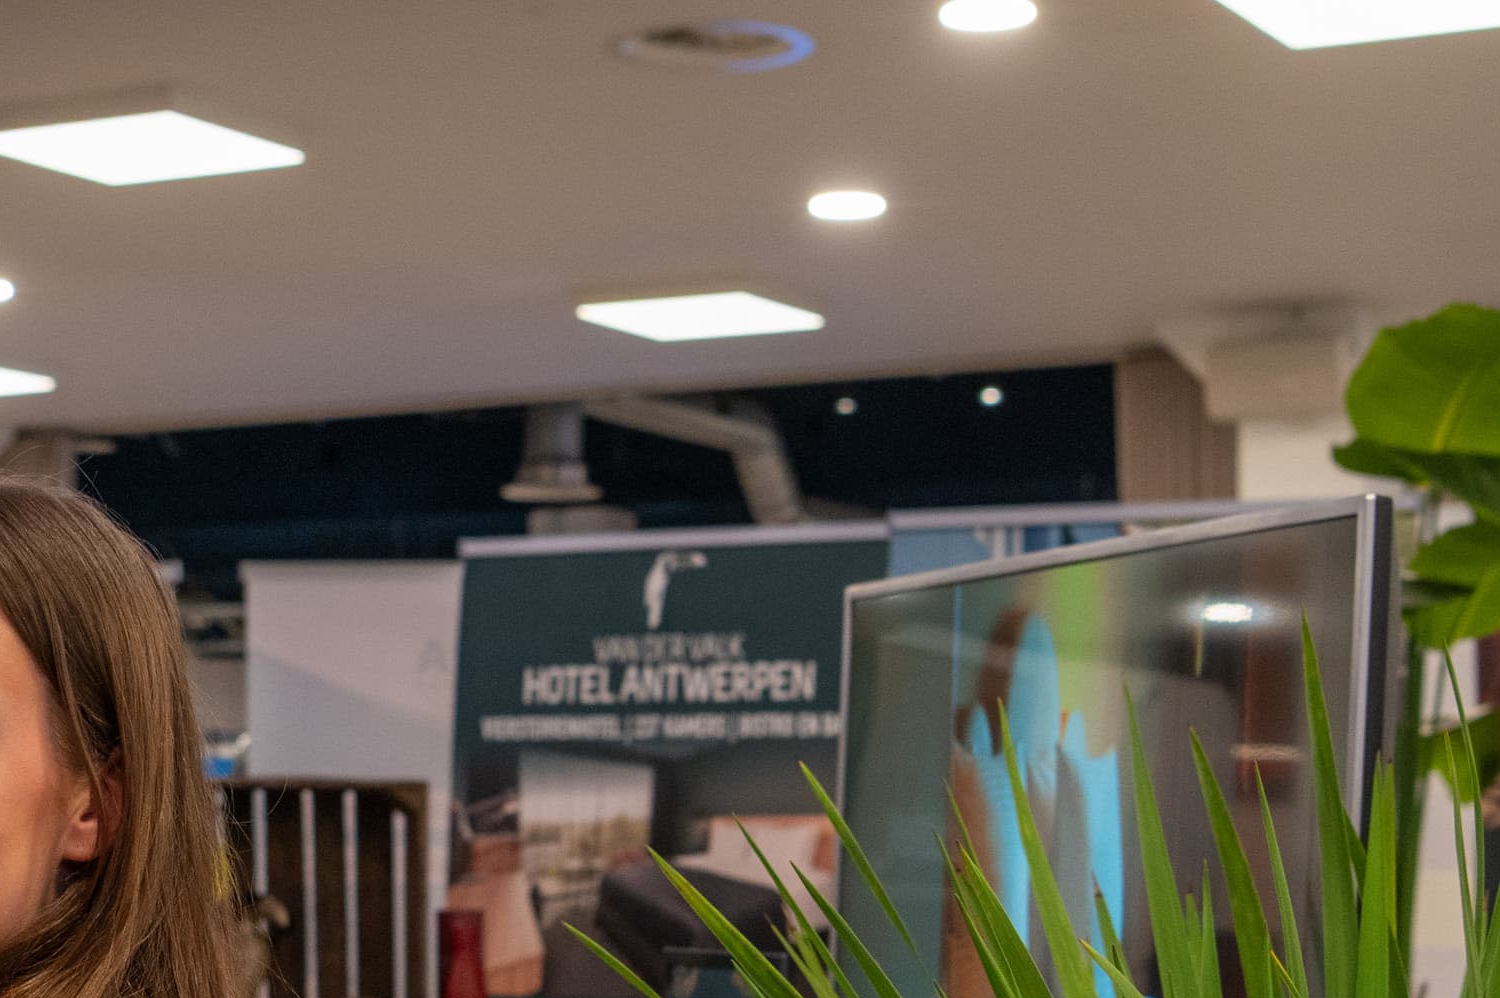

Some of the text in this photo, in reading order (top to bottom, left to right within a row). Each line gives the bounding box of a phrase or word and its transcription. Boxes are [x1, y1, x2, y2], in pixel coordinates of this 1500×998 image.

[593, 631, 746, 663] VAN DER VALK
[522, 660, 817, 706] HOTEL ANTWERPEN
